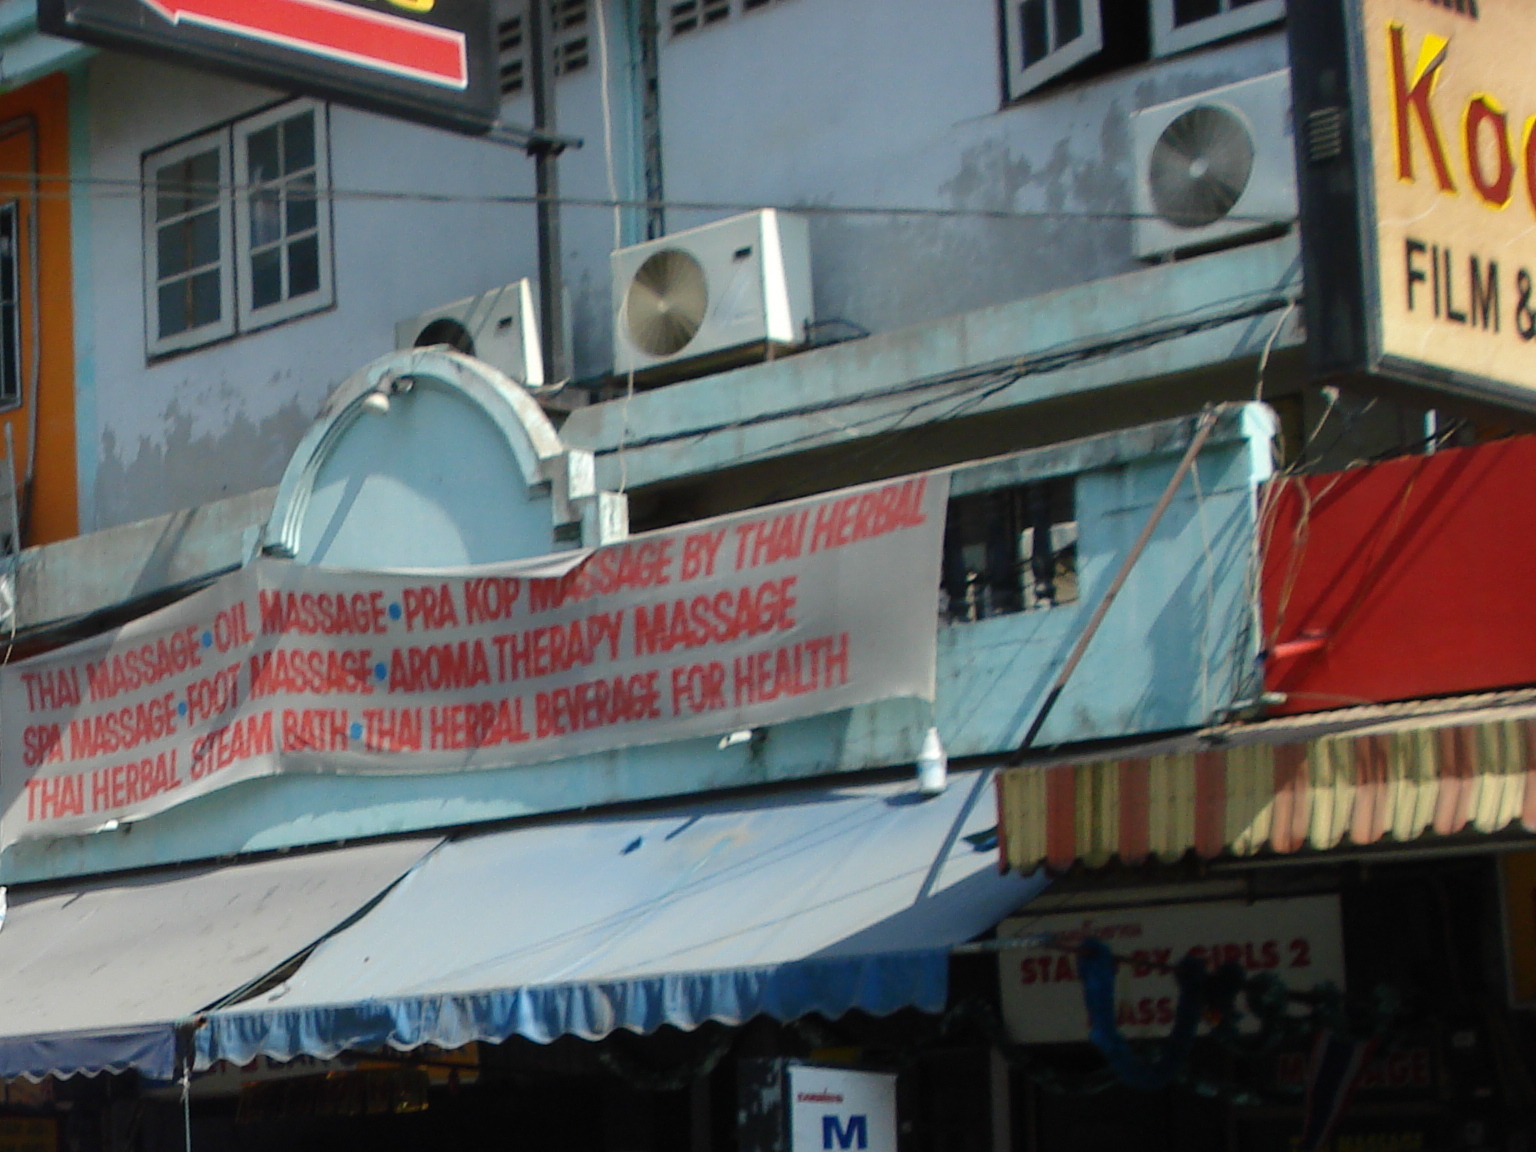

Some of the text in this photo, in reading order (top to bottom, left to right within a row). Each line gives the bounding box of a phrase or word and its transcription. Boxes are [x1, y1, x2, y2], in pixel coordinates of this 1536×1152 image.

[1405, 237, 1500, 335] FILM
[21, 669, 81, 713] THAI
[87, 630, 202, 699] MASSAGE
[212, 600, 255, 654] OIL
[259, 588, 387, 638] MASSAGE
[402, 584, 457, 632] PRA
[464, 576, 521, 626] KOP
[681, 529, 726, 582] BY
[734, 515, 808, 571] THAI
[810, 476, 928, 556] HERBAL
[22, 575, 797, 767] SPA MASSAGE FOOT MASSAGE AROMA THERAPY MASSAGE
[24, 632, 851, 823] THAI HERBAL STEAM BATH THAI HERBAL BEVERAGE FOR HEALTH
[1288, 937, 1311, 968] 2
